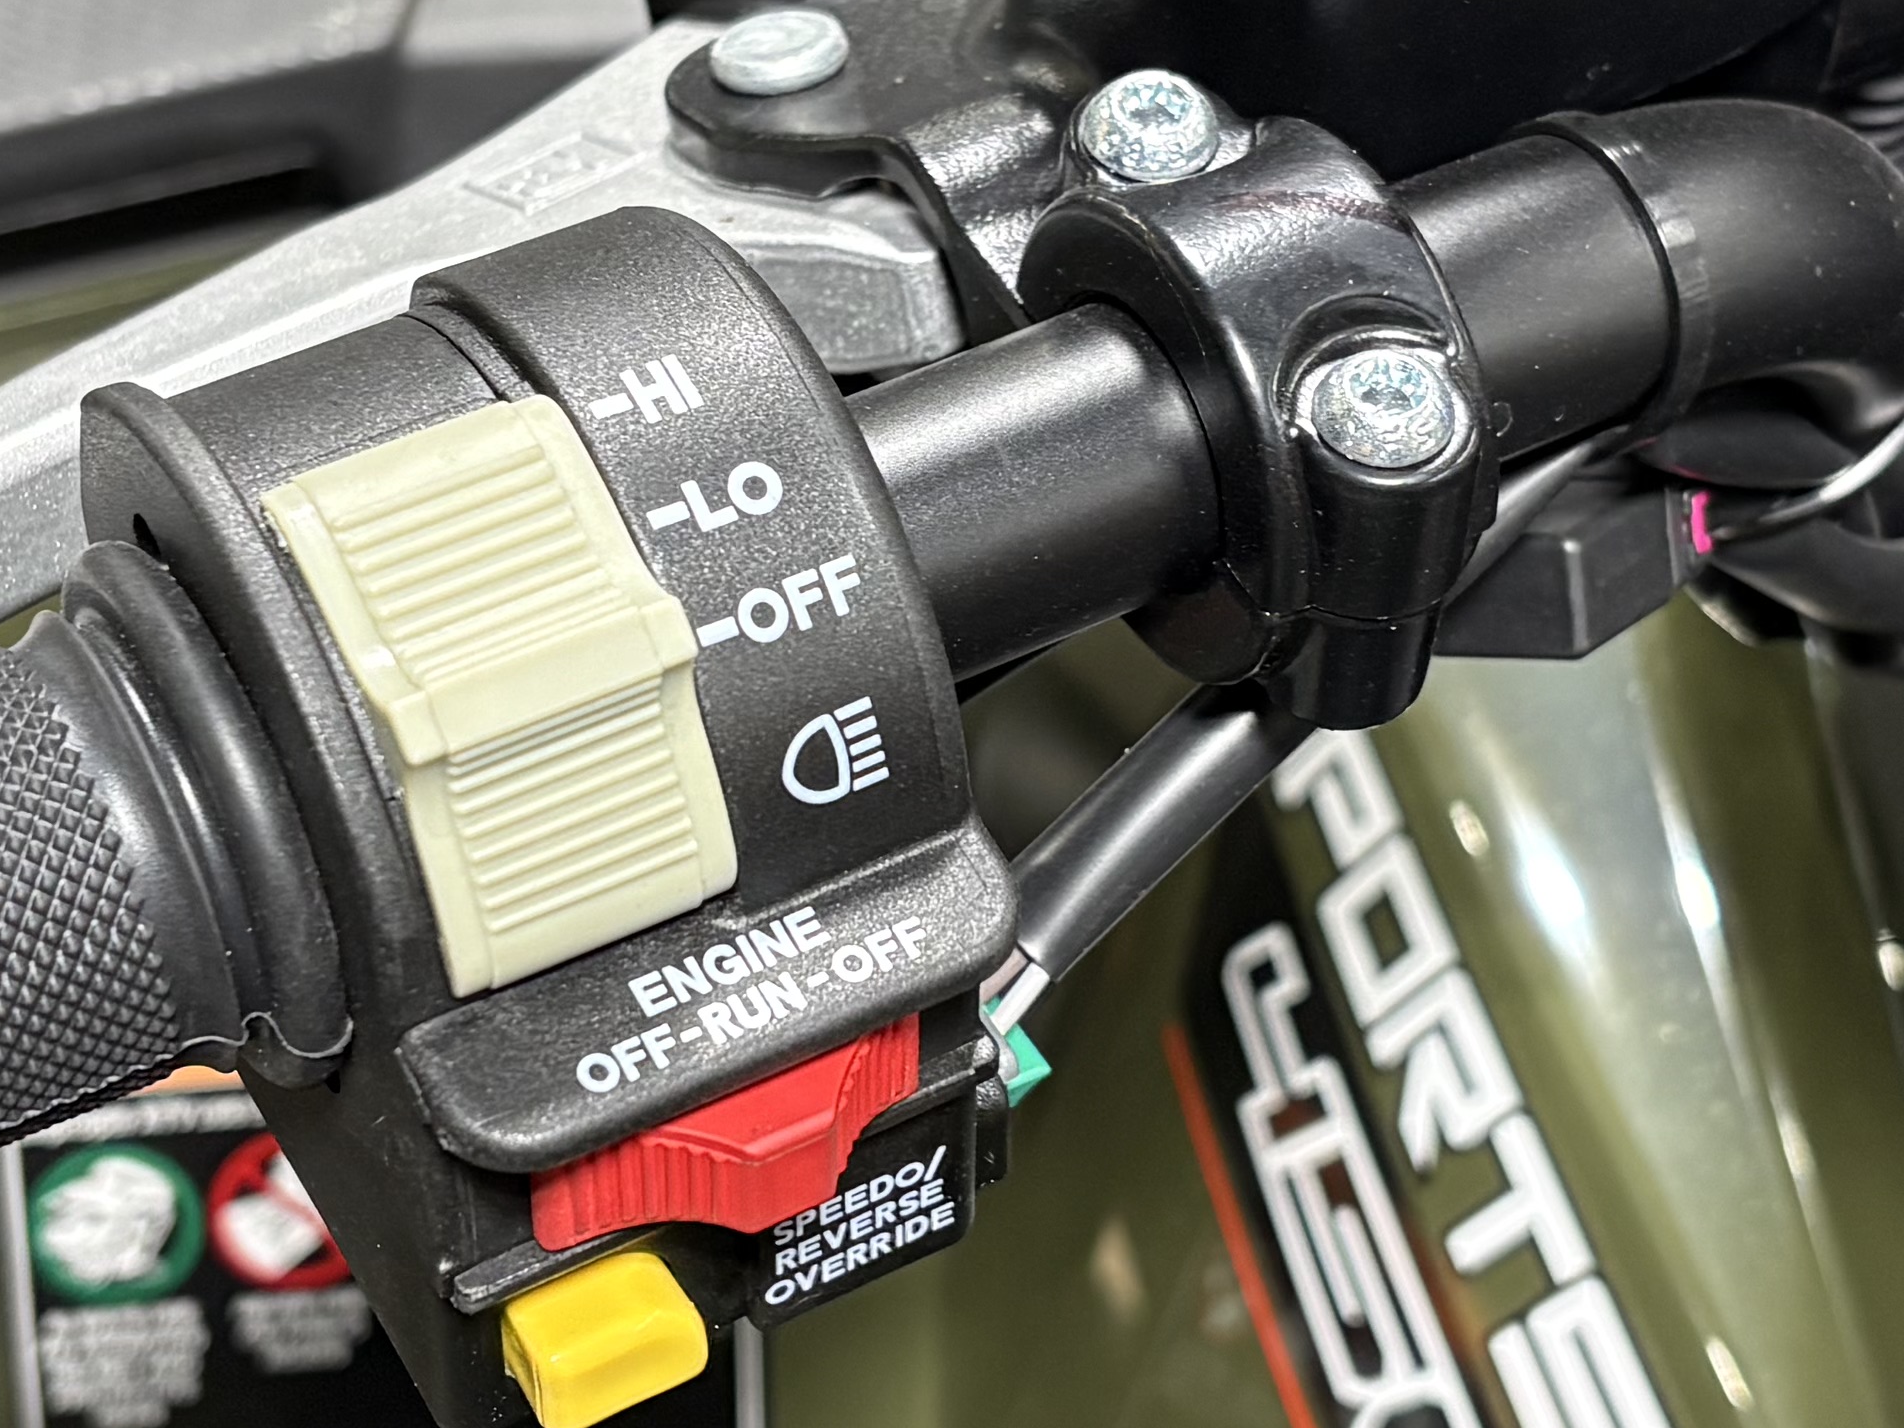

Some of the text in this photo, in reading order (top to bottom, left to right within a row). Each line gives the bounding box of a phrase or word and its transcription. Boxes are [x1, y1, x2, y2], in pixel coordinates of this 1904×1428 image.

[736, 554, 862, 643] OFF
[627, 906, 832, 1018] ENGINE
[773, 1144, 948, 1246] SPEEDO/
[773, 1177, 945, 1276] REVERSE
[763, 1201, 957, 1306] OVERRIDE
